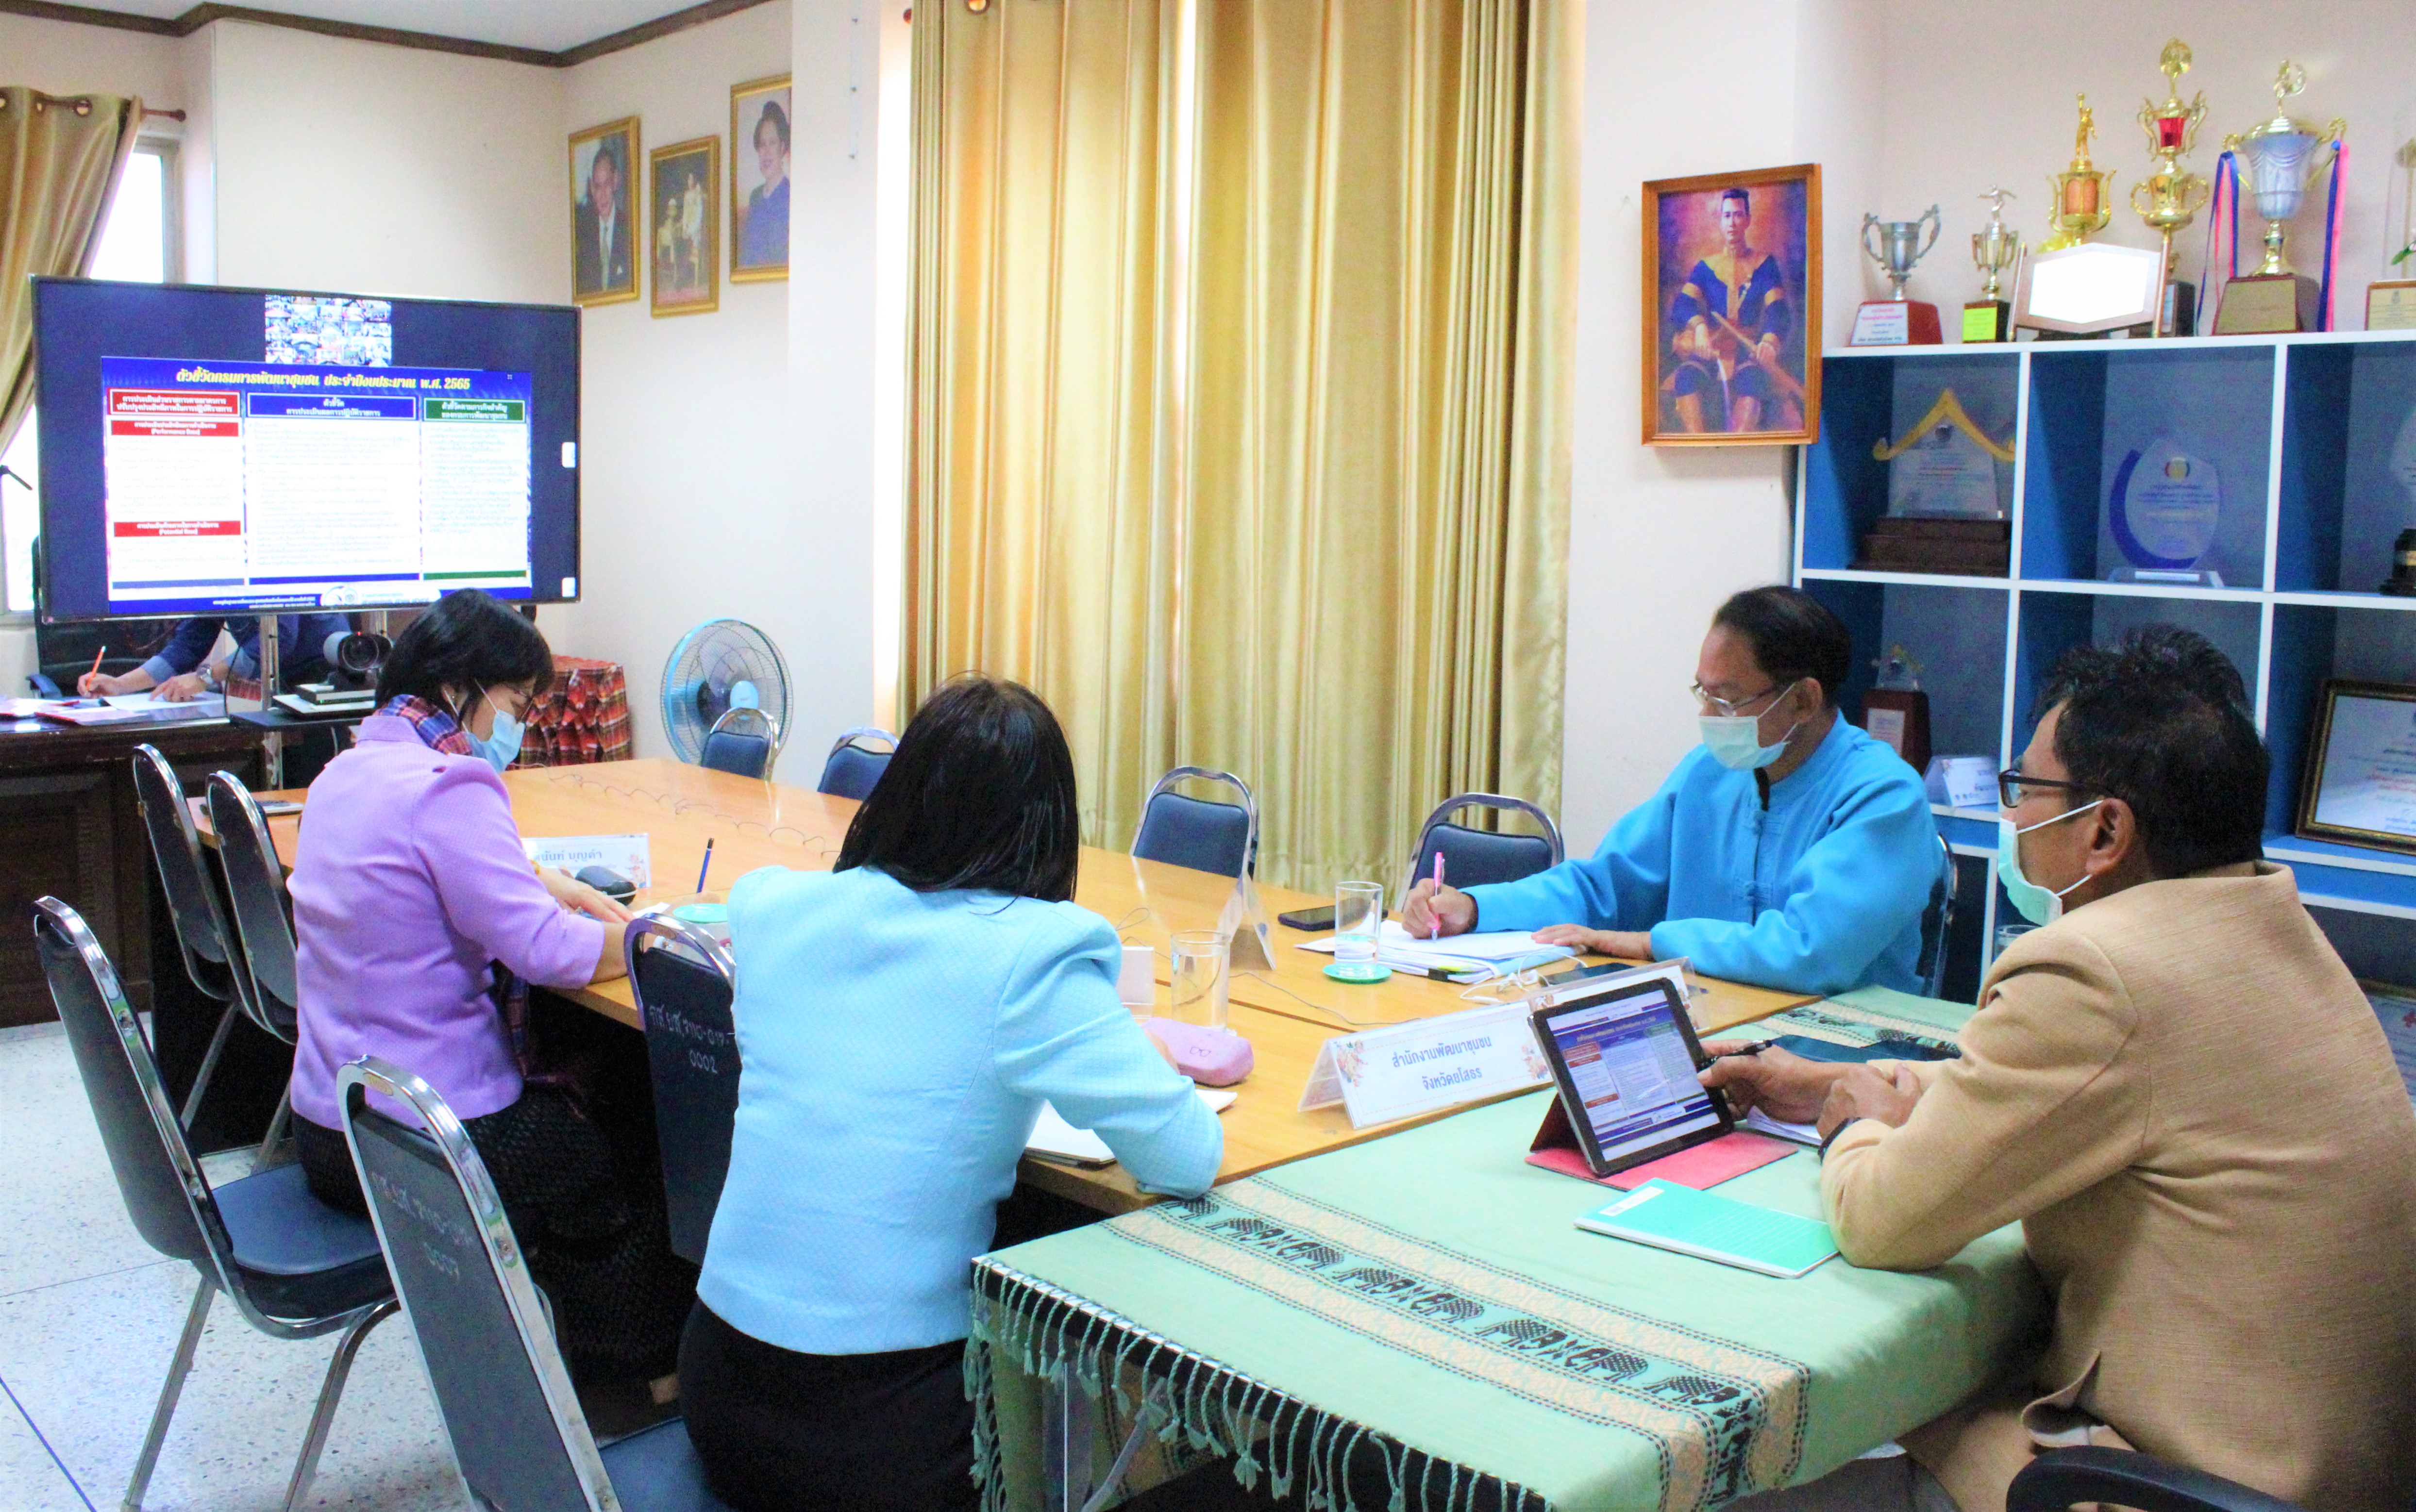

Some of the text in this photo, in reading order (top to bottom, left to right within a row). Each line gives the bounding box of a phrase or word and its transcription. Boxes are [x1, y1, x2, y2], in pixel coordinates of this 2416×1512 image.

[176, 366, 319, 389] ตัวชี้วัดกรมการพัฒนาชุมชน
[323, 373, 417, 388] ประจำปีงบประมาณ
[443, 377, 470, 390] 2565
[689, 1049, 718, 1074] 0002
[1392, 1036, 1493, 1068] สำนักงานพัฒนาชุมชน
[1422, 1066, 1483, 1091] จังหวัดยโสธร
